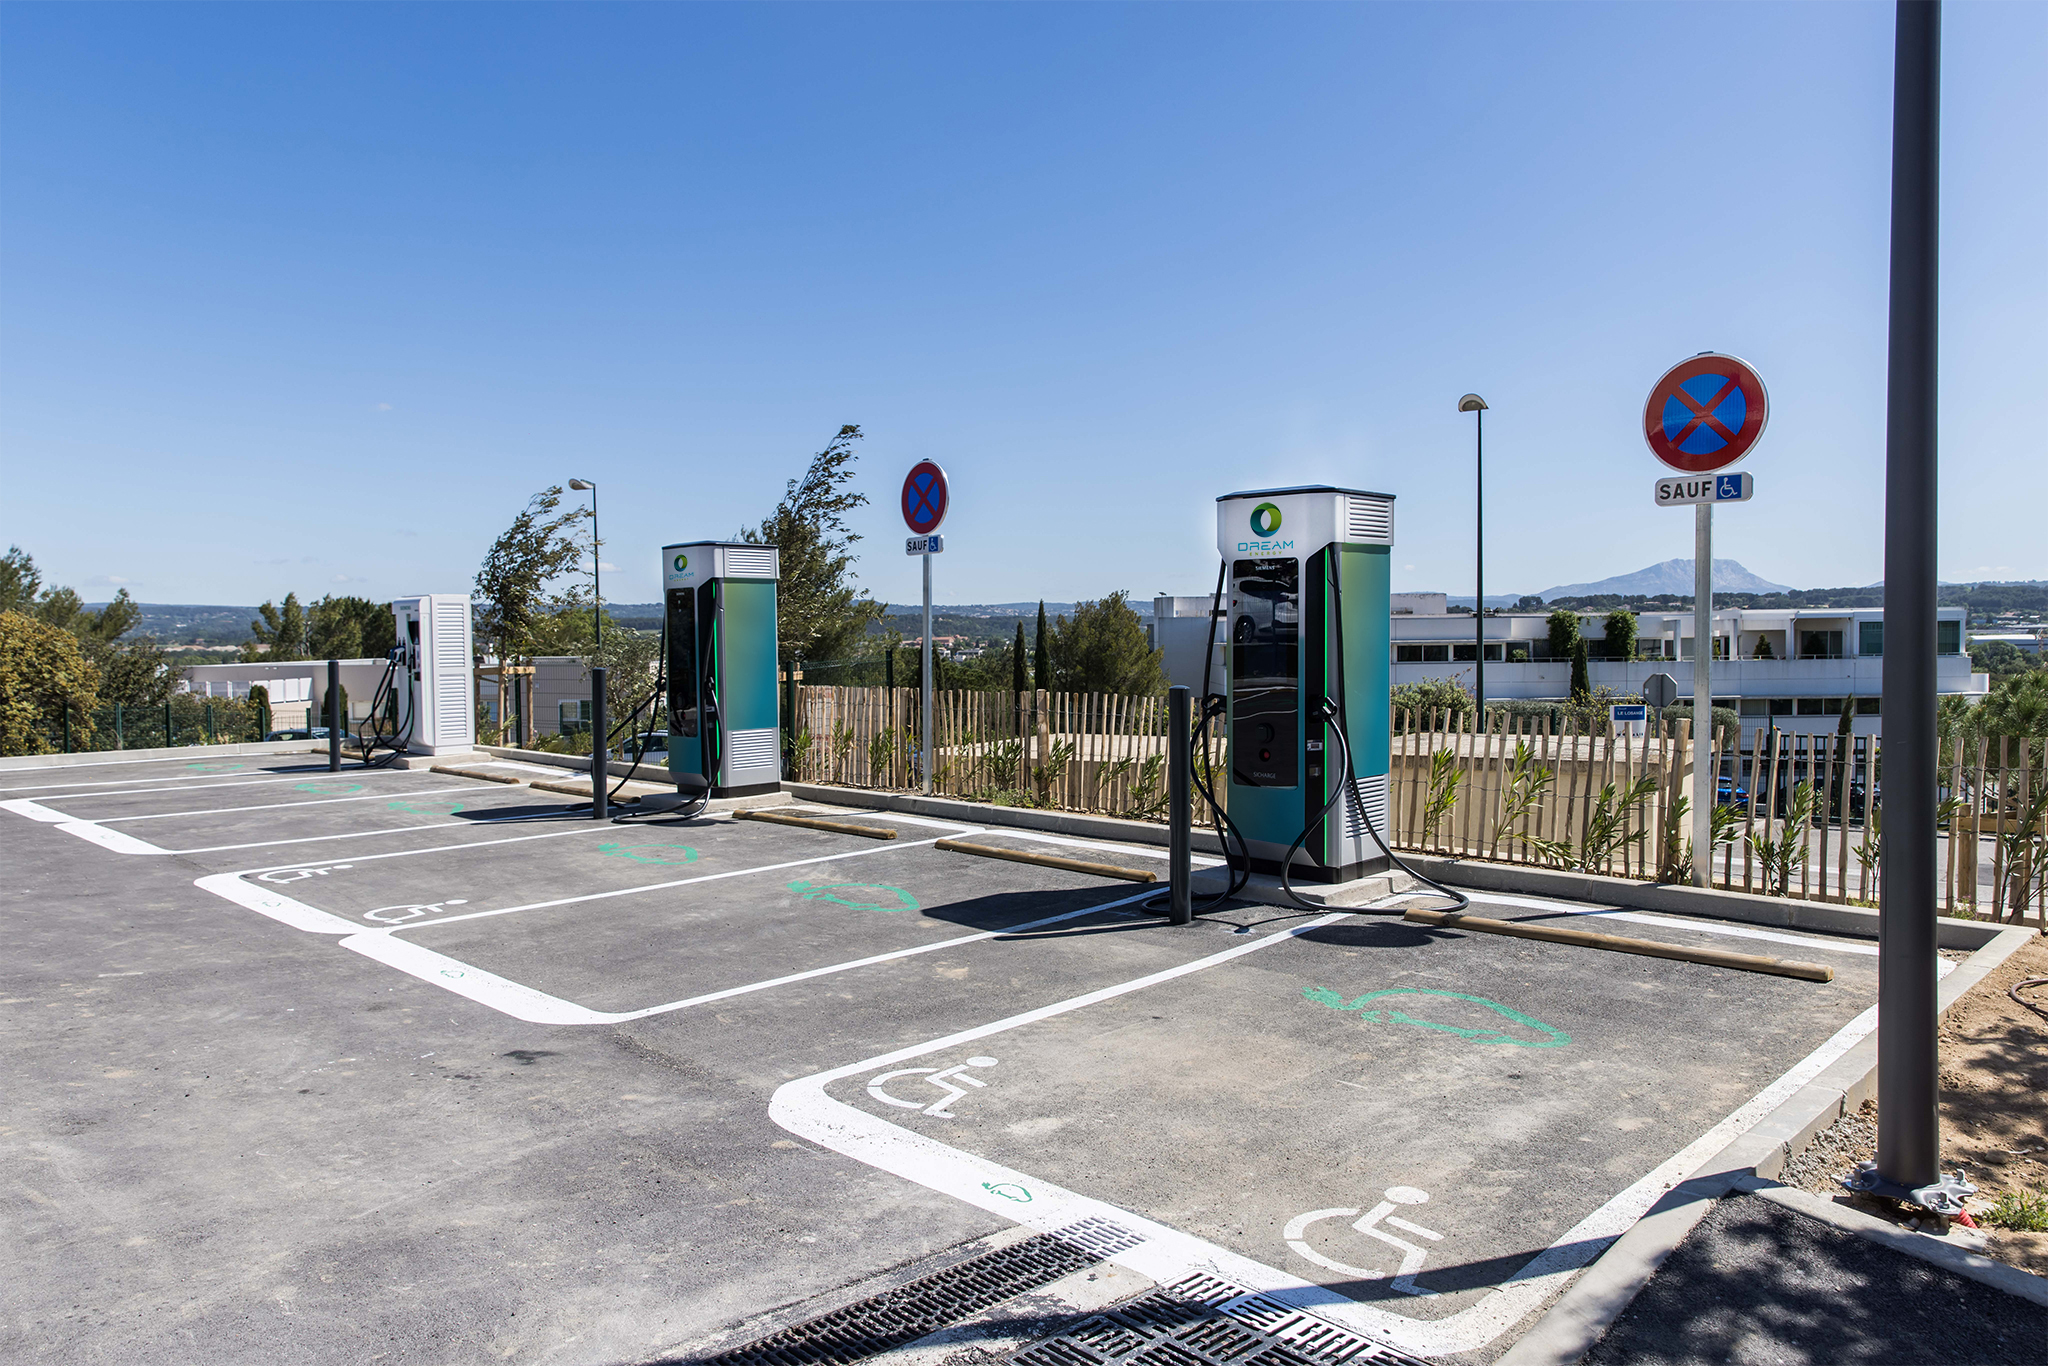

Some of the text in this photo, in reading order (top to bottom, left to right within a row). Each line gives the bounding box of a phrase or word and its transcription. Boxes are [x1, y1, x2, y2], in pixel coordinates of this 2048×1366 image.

[1659, 481, 1713, 500] SAUF
[907, 540, 927, 552] SAUF
[1237, 540, 1294, 552] DREAM
